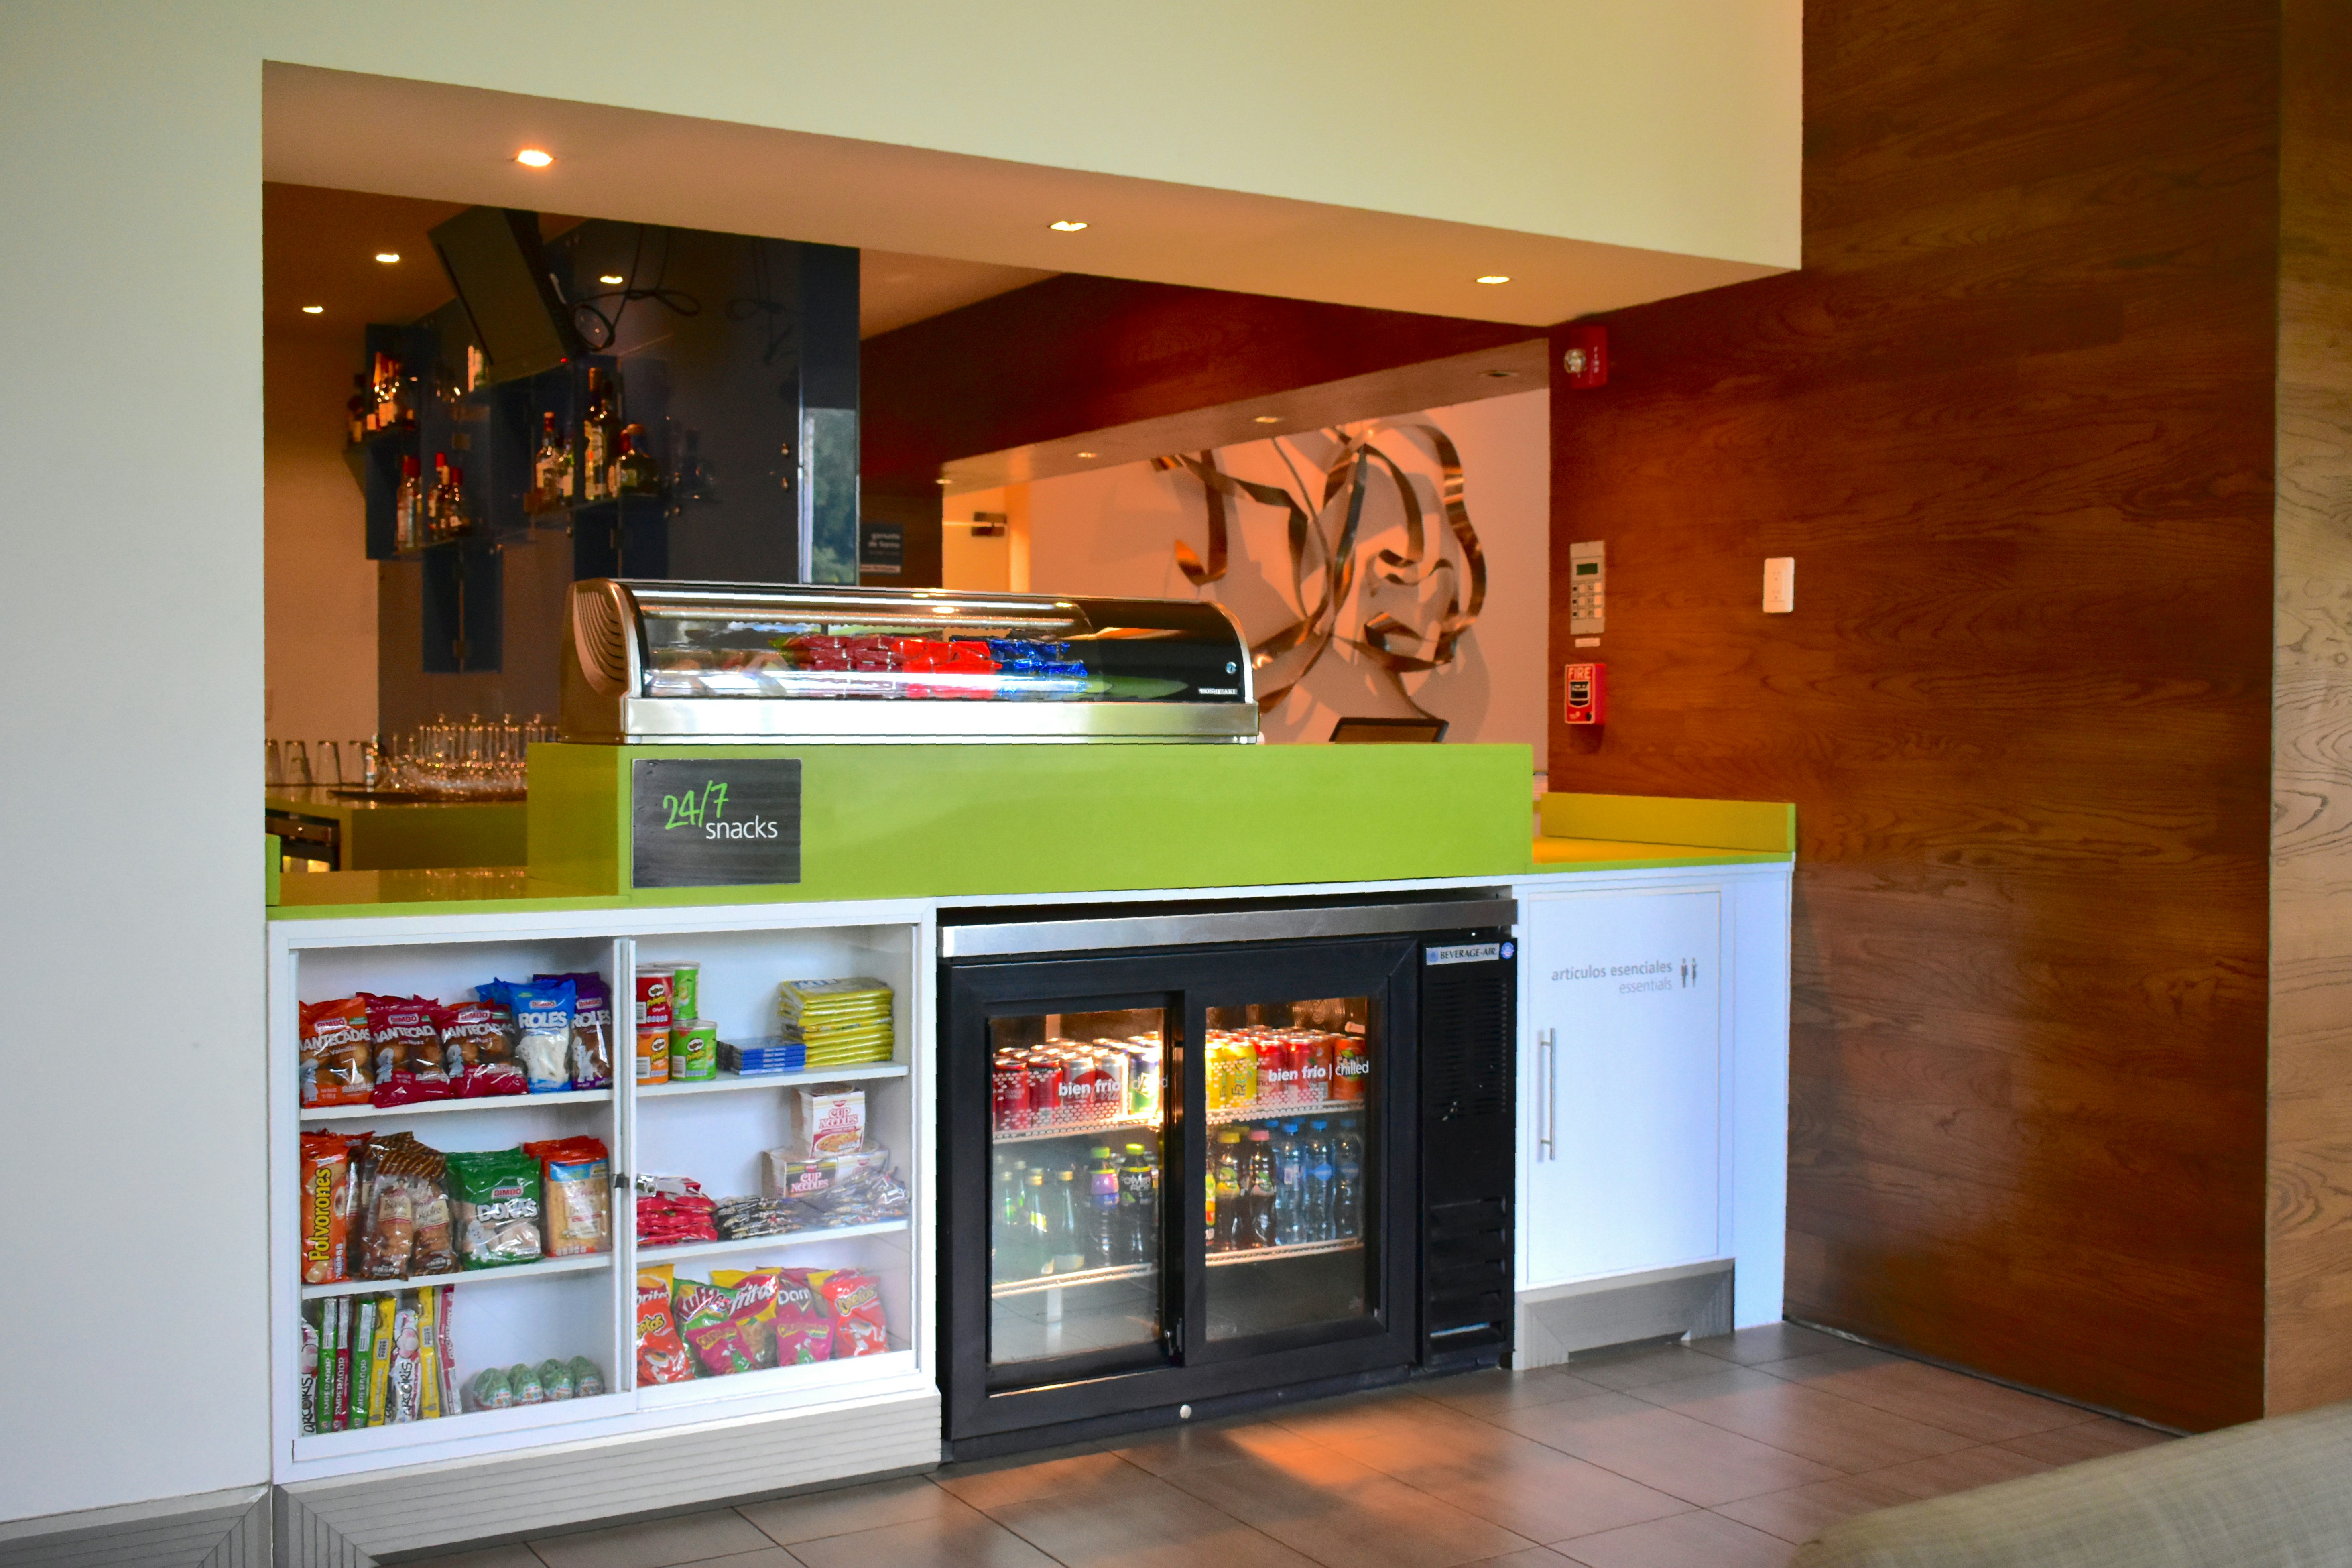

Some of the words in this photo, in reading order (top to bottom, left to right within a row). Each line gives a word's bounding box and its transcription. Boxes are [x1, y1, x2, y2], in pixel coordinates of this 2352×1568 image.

[1568, 667, 1592, 679] FIRE
[663, 780, 729, 830] 24/7
[706, 815, 778, 839] snacks
[1440, 948, 1496, 959] BEVERAGE-AIR
[1610, 960, 1673, 976] esenciales
[1619, 977, 1672, 994] essentials
[518, 1011, 567, 1029] ROLES
[1268, 1068, 1299, 1082] bien
[1335, 1060, 1369, 1076] chilled
[1058, 1081, 1091, 1096] bien
[829, 1107, 851, 1119] CUP
[819, 1114, 858, 1129] NOODLES
[800, 1171, 822, 1182] CUP
[494, 1188, 522, 1196] BIMBO
[791, 1179, 829, 1193] NOODLES
[308, 1167, 332, 1262] Polvorones
[324, 1357, 332, 1415] EMPERADOR
[335, 1357, 345, 1415] EMPERADOR
